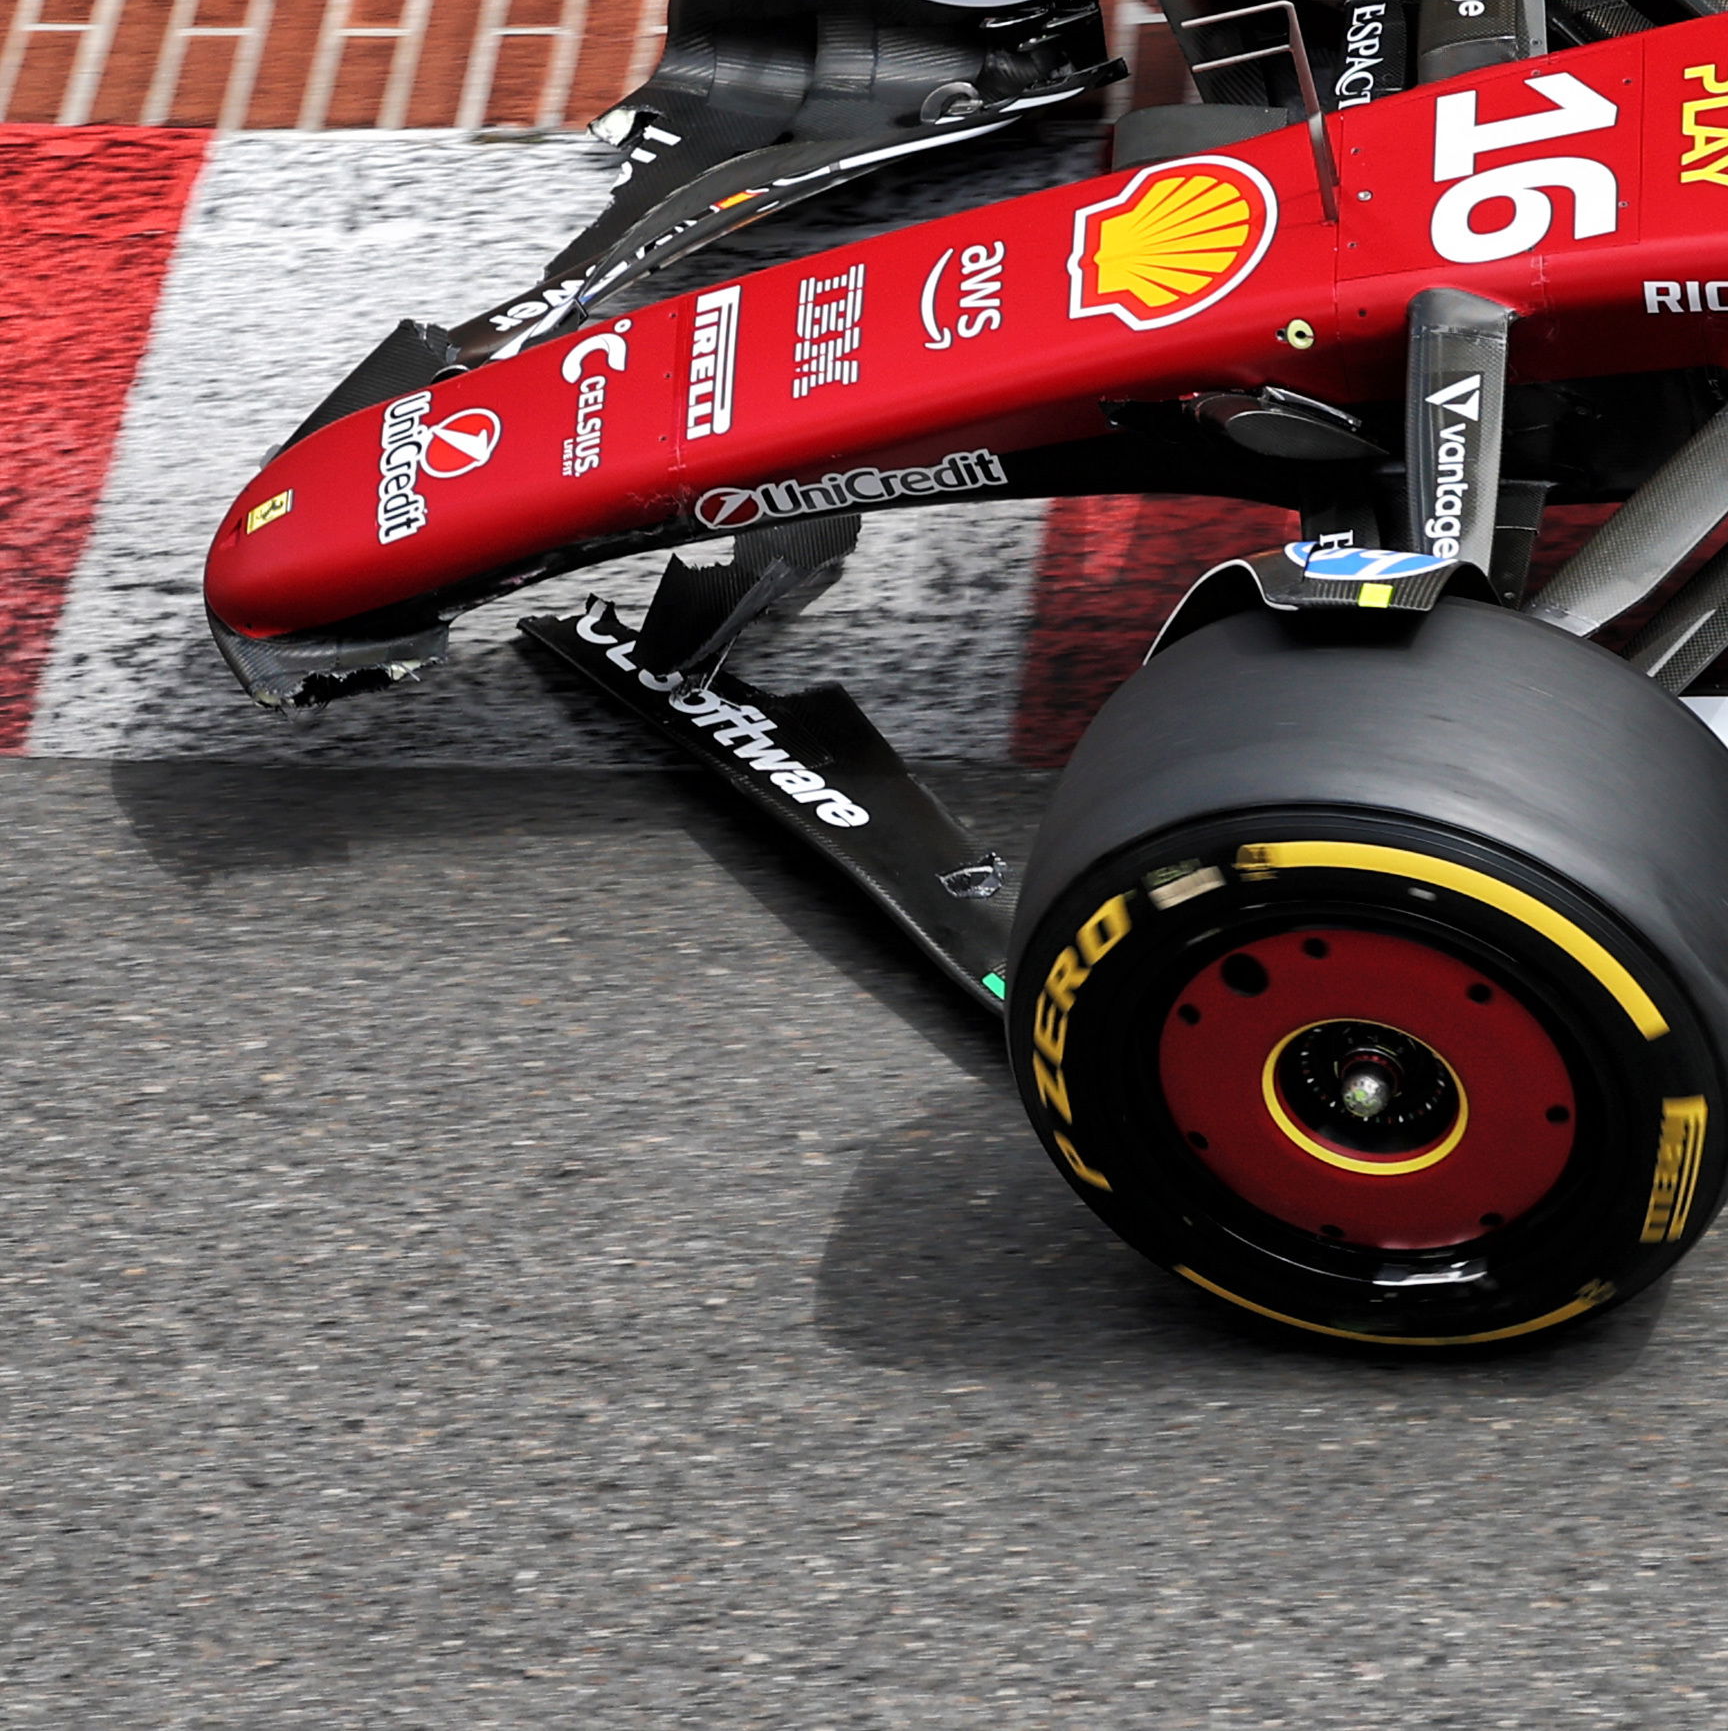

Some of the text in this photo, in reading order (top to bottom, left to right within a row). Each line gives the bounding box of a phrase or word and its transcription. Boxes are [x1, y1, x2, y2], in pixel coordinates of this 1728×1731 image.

[1430, 73, 1618, 263] 16
[792, 263, 864, 399] IBM
[957, 240, 1005, 339] aws
[686, 284, 742, 441] PIRELLI
[378, 390, 430, 543] UniCredit
[757, 448, 1008, 520] UniCredit
[1425, 423, 1468, 558] vantage
[1033, 894, 1132, 1125] ZERO
